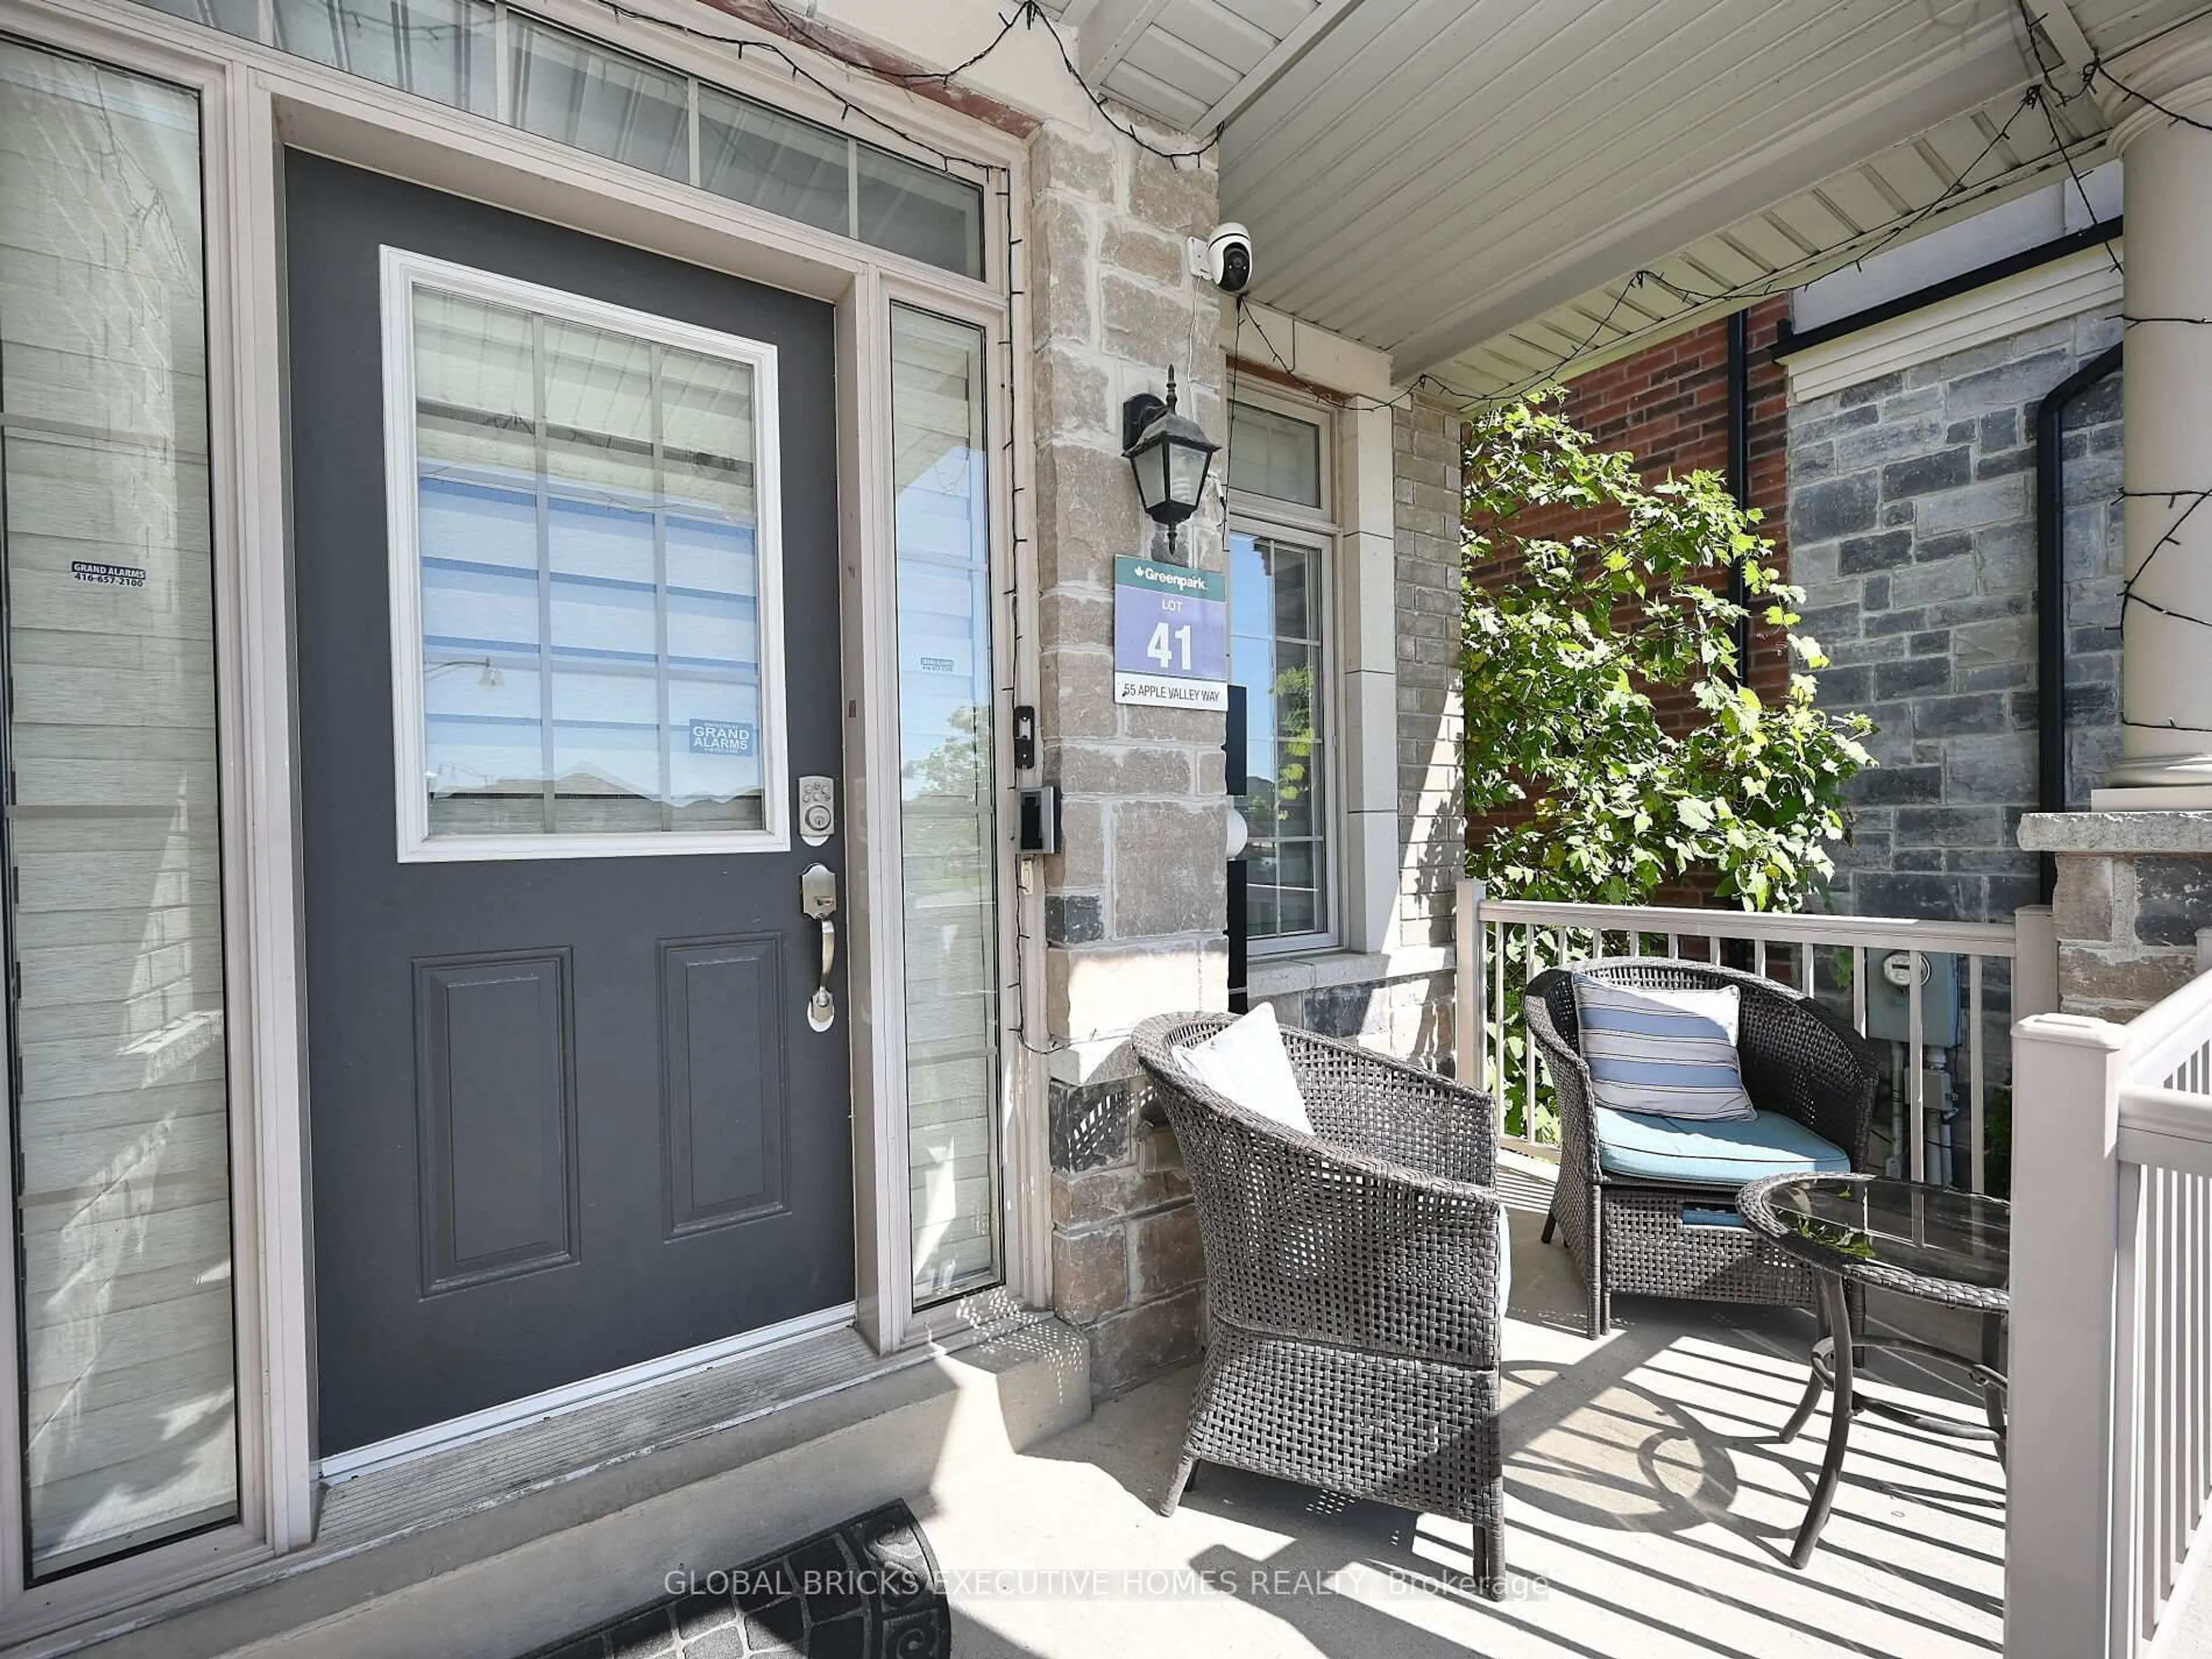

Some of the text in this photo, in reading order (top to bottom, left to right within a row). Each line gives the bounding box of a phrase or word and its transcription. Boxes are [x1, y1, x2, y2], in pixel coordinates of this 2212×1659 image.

[73, 563, 145, 578] GRAND ALARMS
[1145, 567, 1206, 590] Greenpark
[1162, 599, 1183, 612] LOT
[1146, 622, 1192, 670] 41
[1124, 683, 1219, 702] 55 APPLE VALLEY WAY
[693, 726, 749, 740] GRAND
[694, 737, 748, 749] ALARMS
